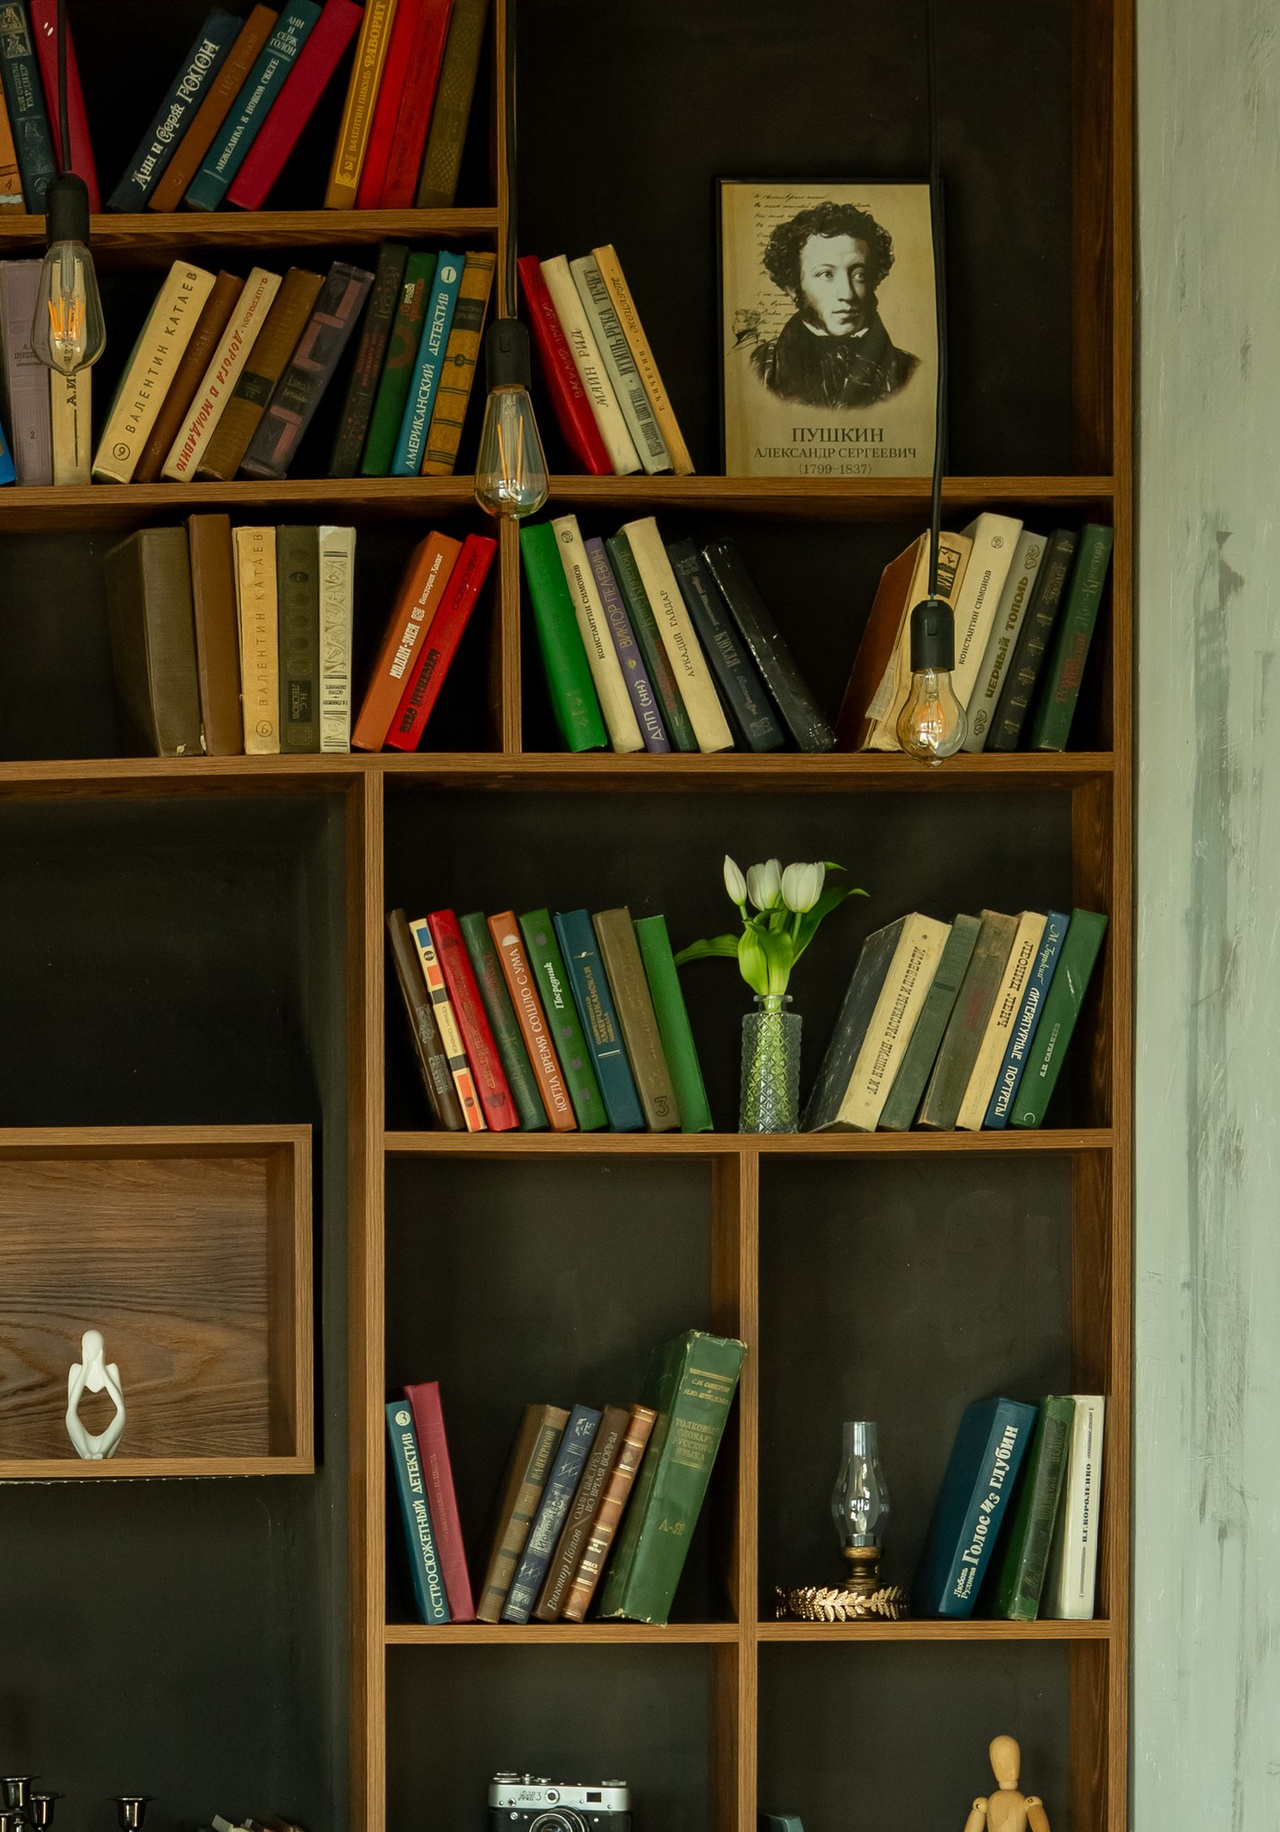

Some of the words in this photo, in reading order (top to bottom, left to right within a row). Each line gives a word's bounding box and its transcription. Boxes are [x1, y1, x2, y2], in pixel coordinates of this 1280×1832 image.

[275, 30, 299, 47] СЕРЖ
[285, 15, 305, 30] АНН
[363, 0, 387, 68] ФАВОРИТ
[268, 37, 297, 56] ГОЛОН
[18, 63, 35, 108] ГАРДНЕР
[174, 37, 220, 104] ГОЛОН
[260, 57, 281, 85] СВЕТЕ
[356, 70, 371, 104] ПИКУЛЬ
[239, 114, 250, 124] В
[244, 83, 267, 115] НОВОМ
[154, 99, 188, 144] Серж
[348, 104, 364, 151] ВАЛЕНТИН
[151, 142, 163, 155] и
[213, 123, 245, 172] АНЖЕЛИКА
[129, 152, 160, 191] Анн
[582, 265, 610, 304] ТЕЧЕТ
[124, 343, 168, 433] ВАЛЕНТИН
[163, 269, 198, 336] КАТАЕВ
[568, 326, 590, 359] РИД
[597, 306, 635, 377] ИТИЛЬ-РЕКА
[401, 362, 436, 468] АМЕРИКАНСКИЙ
[426, 292, 450, 355] ДЕТЕКТИВ
[582, 363, 611, 410] МАЙН
[754, 447, 836, 459] АЛЕКСАНДР
[838, 447, 917, 458] СЕРГЕЕВИЧ
[792, 427, 884, 443] ПУШКИН
[799, 464, 873, 475] (1799–1837)
[253, 533, 264, 599] КАТАЕВ
[571, 563, 590, 603] СИМОНОВ
[588, 547, 619, 602] ПЕЛЕВИН
[606, 601, 634, 648] ВИКТОР
[658, 588, 678, 627] ГАЙДАР
[957, 610, 980, 665] КОНСТАНТИН
[973, 568, 992, 610] СИМОНОВ
[583, 604, 607, 659] КОНСТАНТИН
[982, 636, 1011, 698] ЧЕРНЫЙ
[1004, 574, 1030, 632] ТОПОЛЬ
[256, 612, 268, 705] ВАЛЕНТИН
[672, 631, 696, 678] АРКАДИЙ
[291, 684, 299, 719] ЛЕСКОВ
[1045, 923, 1061, 945] М.
[508, 947, 525, 974] УМА
[516, 974, 528, 985] С
[1007, 939, 1034, 991] ЛЕОНИД
[1031, 942, 1056, 986] Горький
[542, 959, 566, 1010] Посредник
[582, 964, 609, 1043] АМЕРИКАНСКАЯ
[519, 986, 543, 1033] СОШЛО
[996, 992, 1017, 1029] ЛЕНЧ
[1009, 986, 1041, 1060] ЛИТЕРАТУРНЫЕ
[535, 1034, 556, 1073] ВРЕМЯ
[548, 1073, 569, 1112] КОГДА
[993, 1064, 1018, 1117] ПОРТРЕТЫ
[400, 1431, 423, 1495] ДЕТЕКТИВ
[598, 1430, 618, 1466] ВОЙНЫ
[982, 1423, 1025, 1490] глубин
[572, 1491, 589, 1520] ОДИН
[582, 1449, 602, 1491] ВЫСТРЕЛ
[589, 1466, 606, 1497] ВРЕМЯ
[978, 1489, 1001, 1515] из
[584, 1497, 595, 1512] ВО
[657, 1518, 686, 1536] А-Я
[960, 1512, 994, 1565] Голос
[411, 1498, 446, 1618] ОСТРОСЮЖЕТНЫЙ
[546, 1562, 571, 1612] Виктор
[561, 1526, 583, 1564] Попов
[951, 1565, 970, 1597] Любовь
[959, 1565, 979, 1599] Руднева
